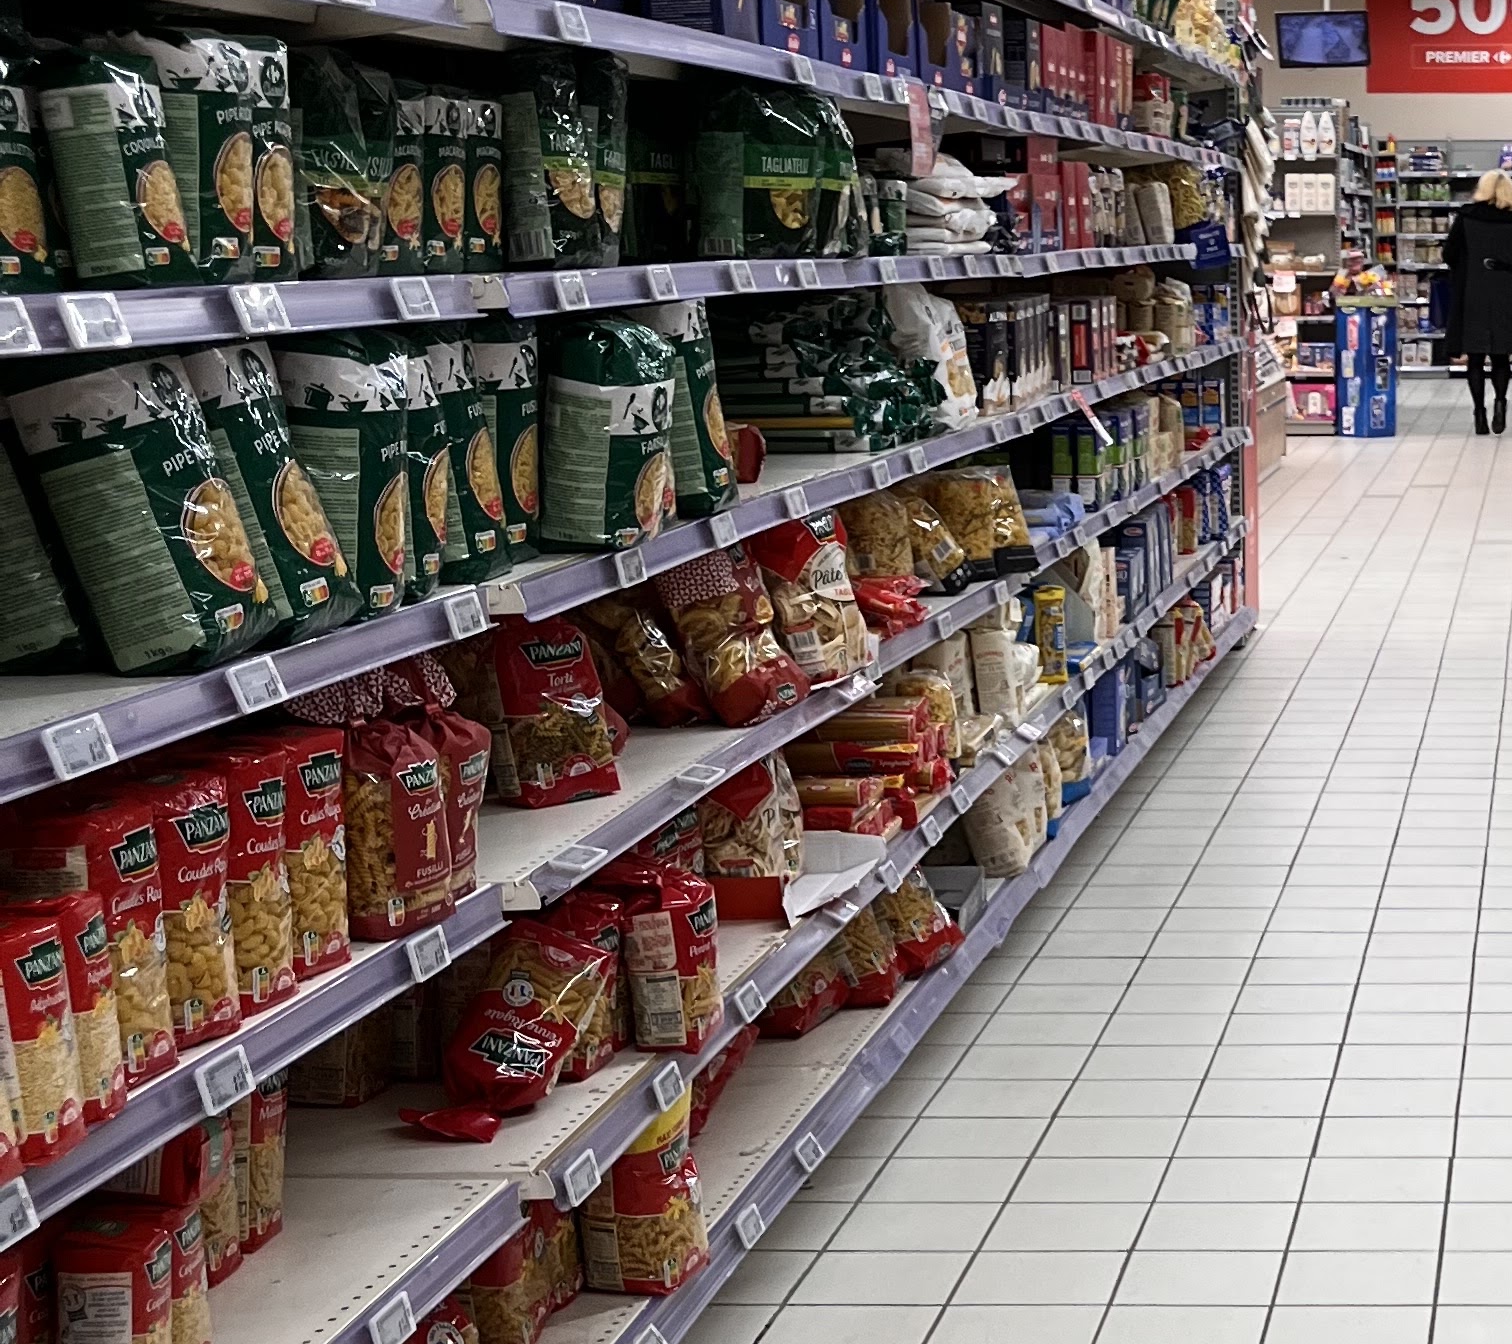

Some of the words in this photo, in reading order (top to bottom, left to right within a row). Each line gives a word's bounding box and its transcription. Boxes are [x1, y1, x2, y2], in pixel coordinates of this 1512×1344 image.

[1424, 50, 1490, 64] PREMIER
[253, 429, 281, 455] PIPE
[162, 448, 195, 477] PIPE
[528, 640, 581, 661] PANZANI
[547, 670, 574, 687] Torti
[177, 862, 213, 883] Coudes
[416, 861, 444, 878] FUSILLI
[111, 892, 146, 915] Coudes
[484, 1007, 528, 1029] Rigate
[481, 1033, 543, 1069] PANZANI
